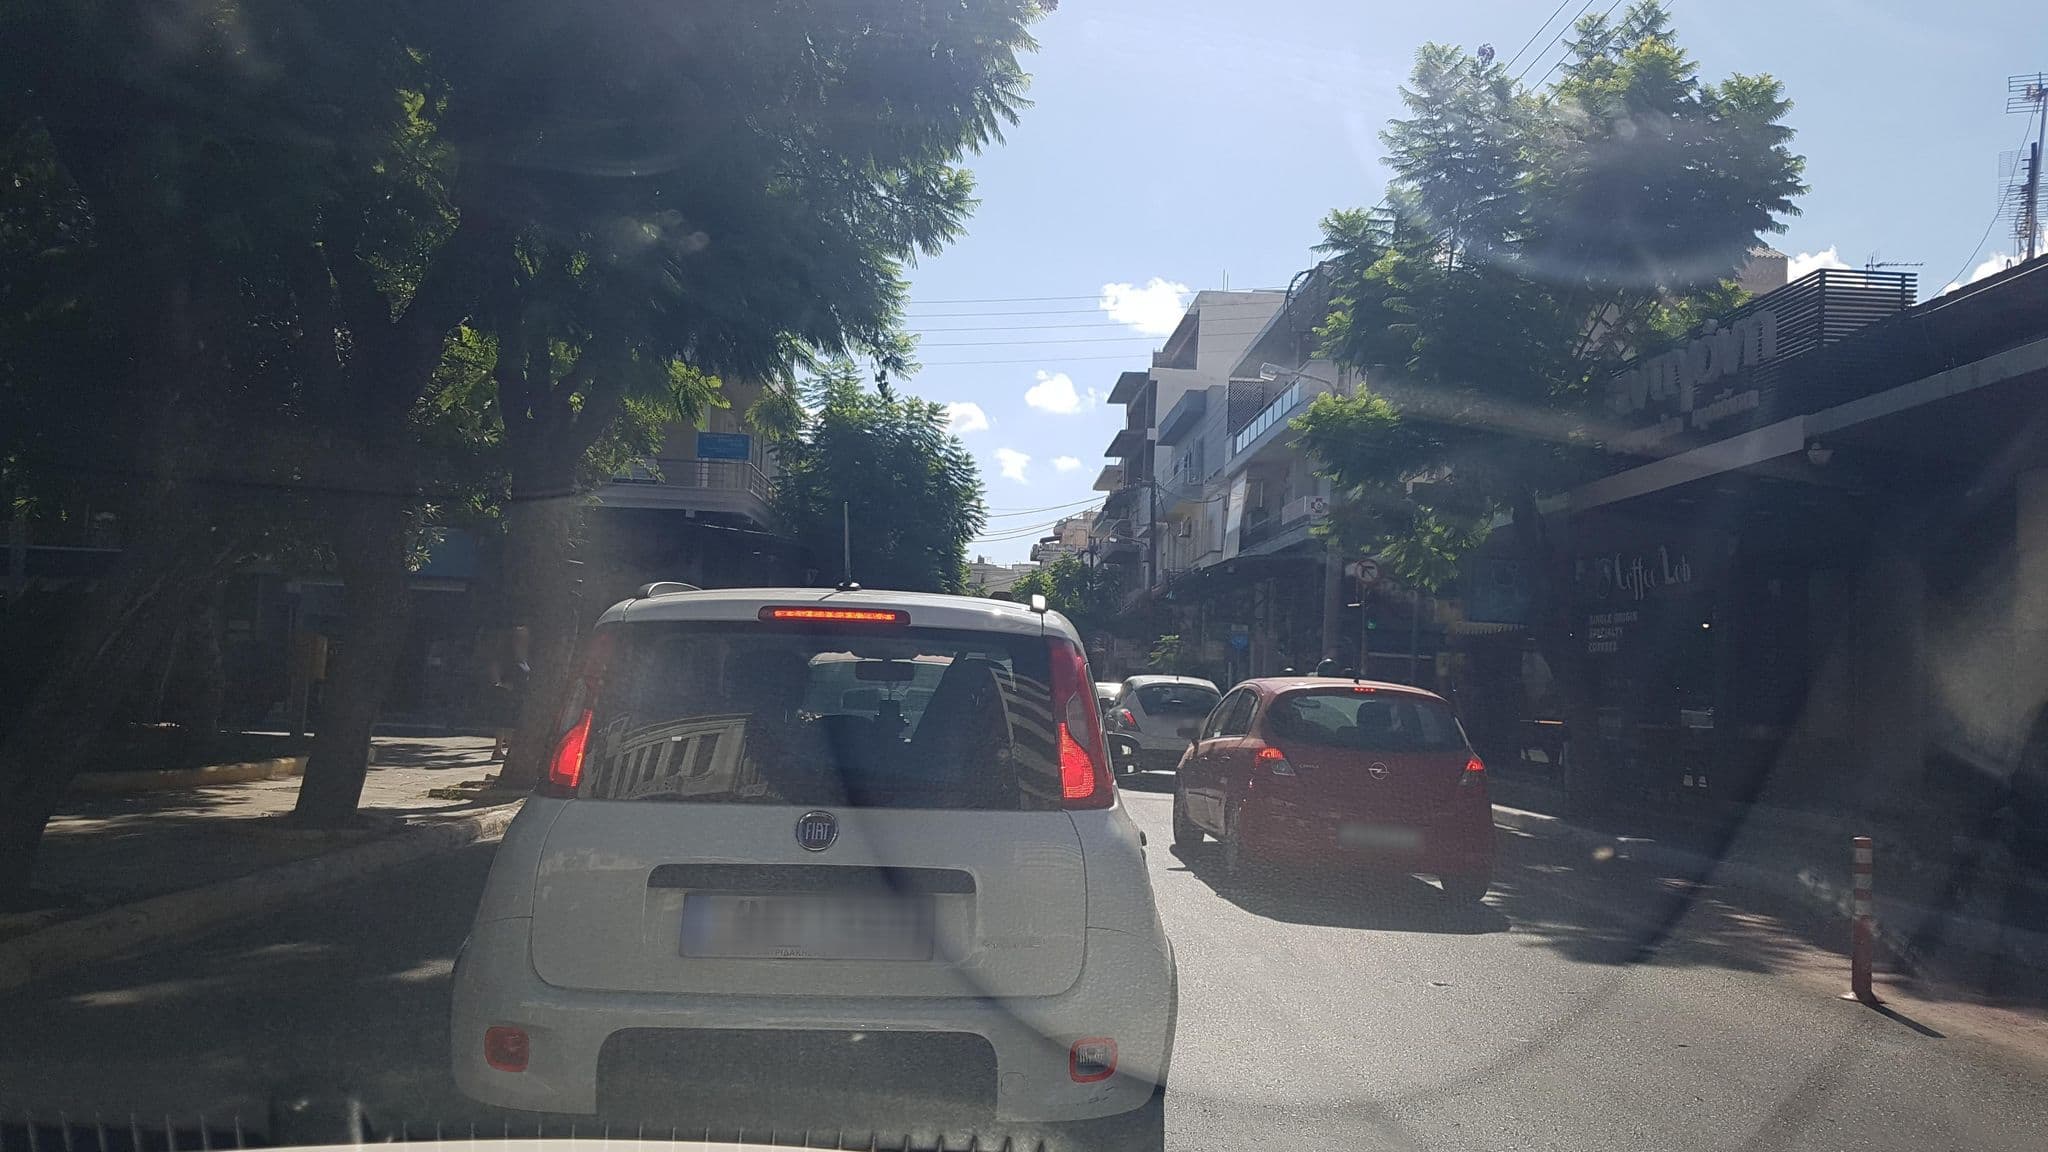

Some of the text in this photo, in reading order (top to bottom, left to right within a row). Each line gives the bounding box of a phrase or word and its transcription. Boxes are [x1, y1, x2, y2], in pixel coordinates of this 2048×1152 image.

[1614, 545, 1692, 600] Coffee Lab
[804, 822, 831, 840] FIAT
